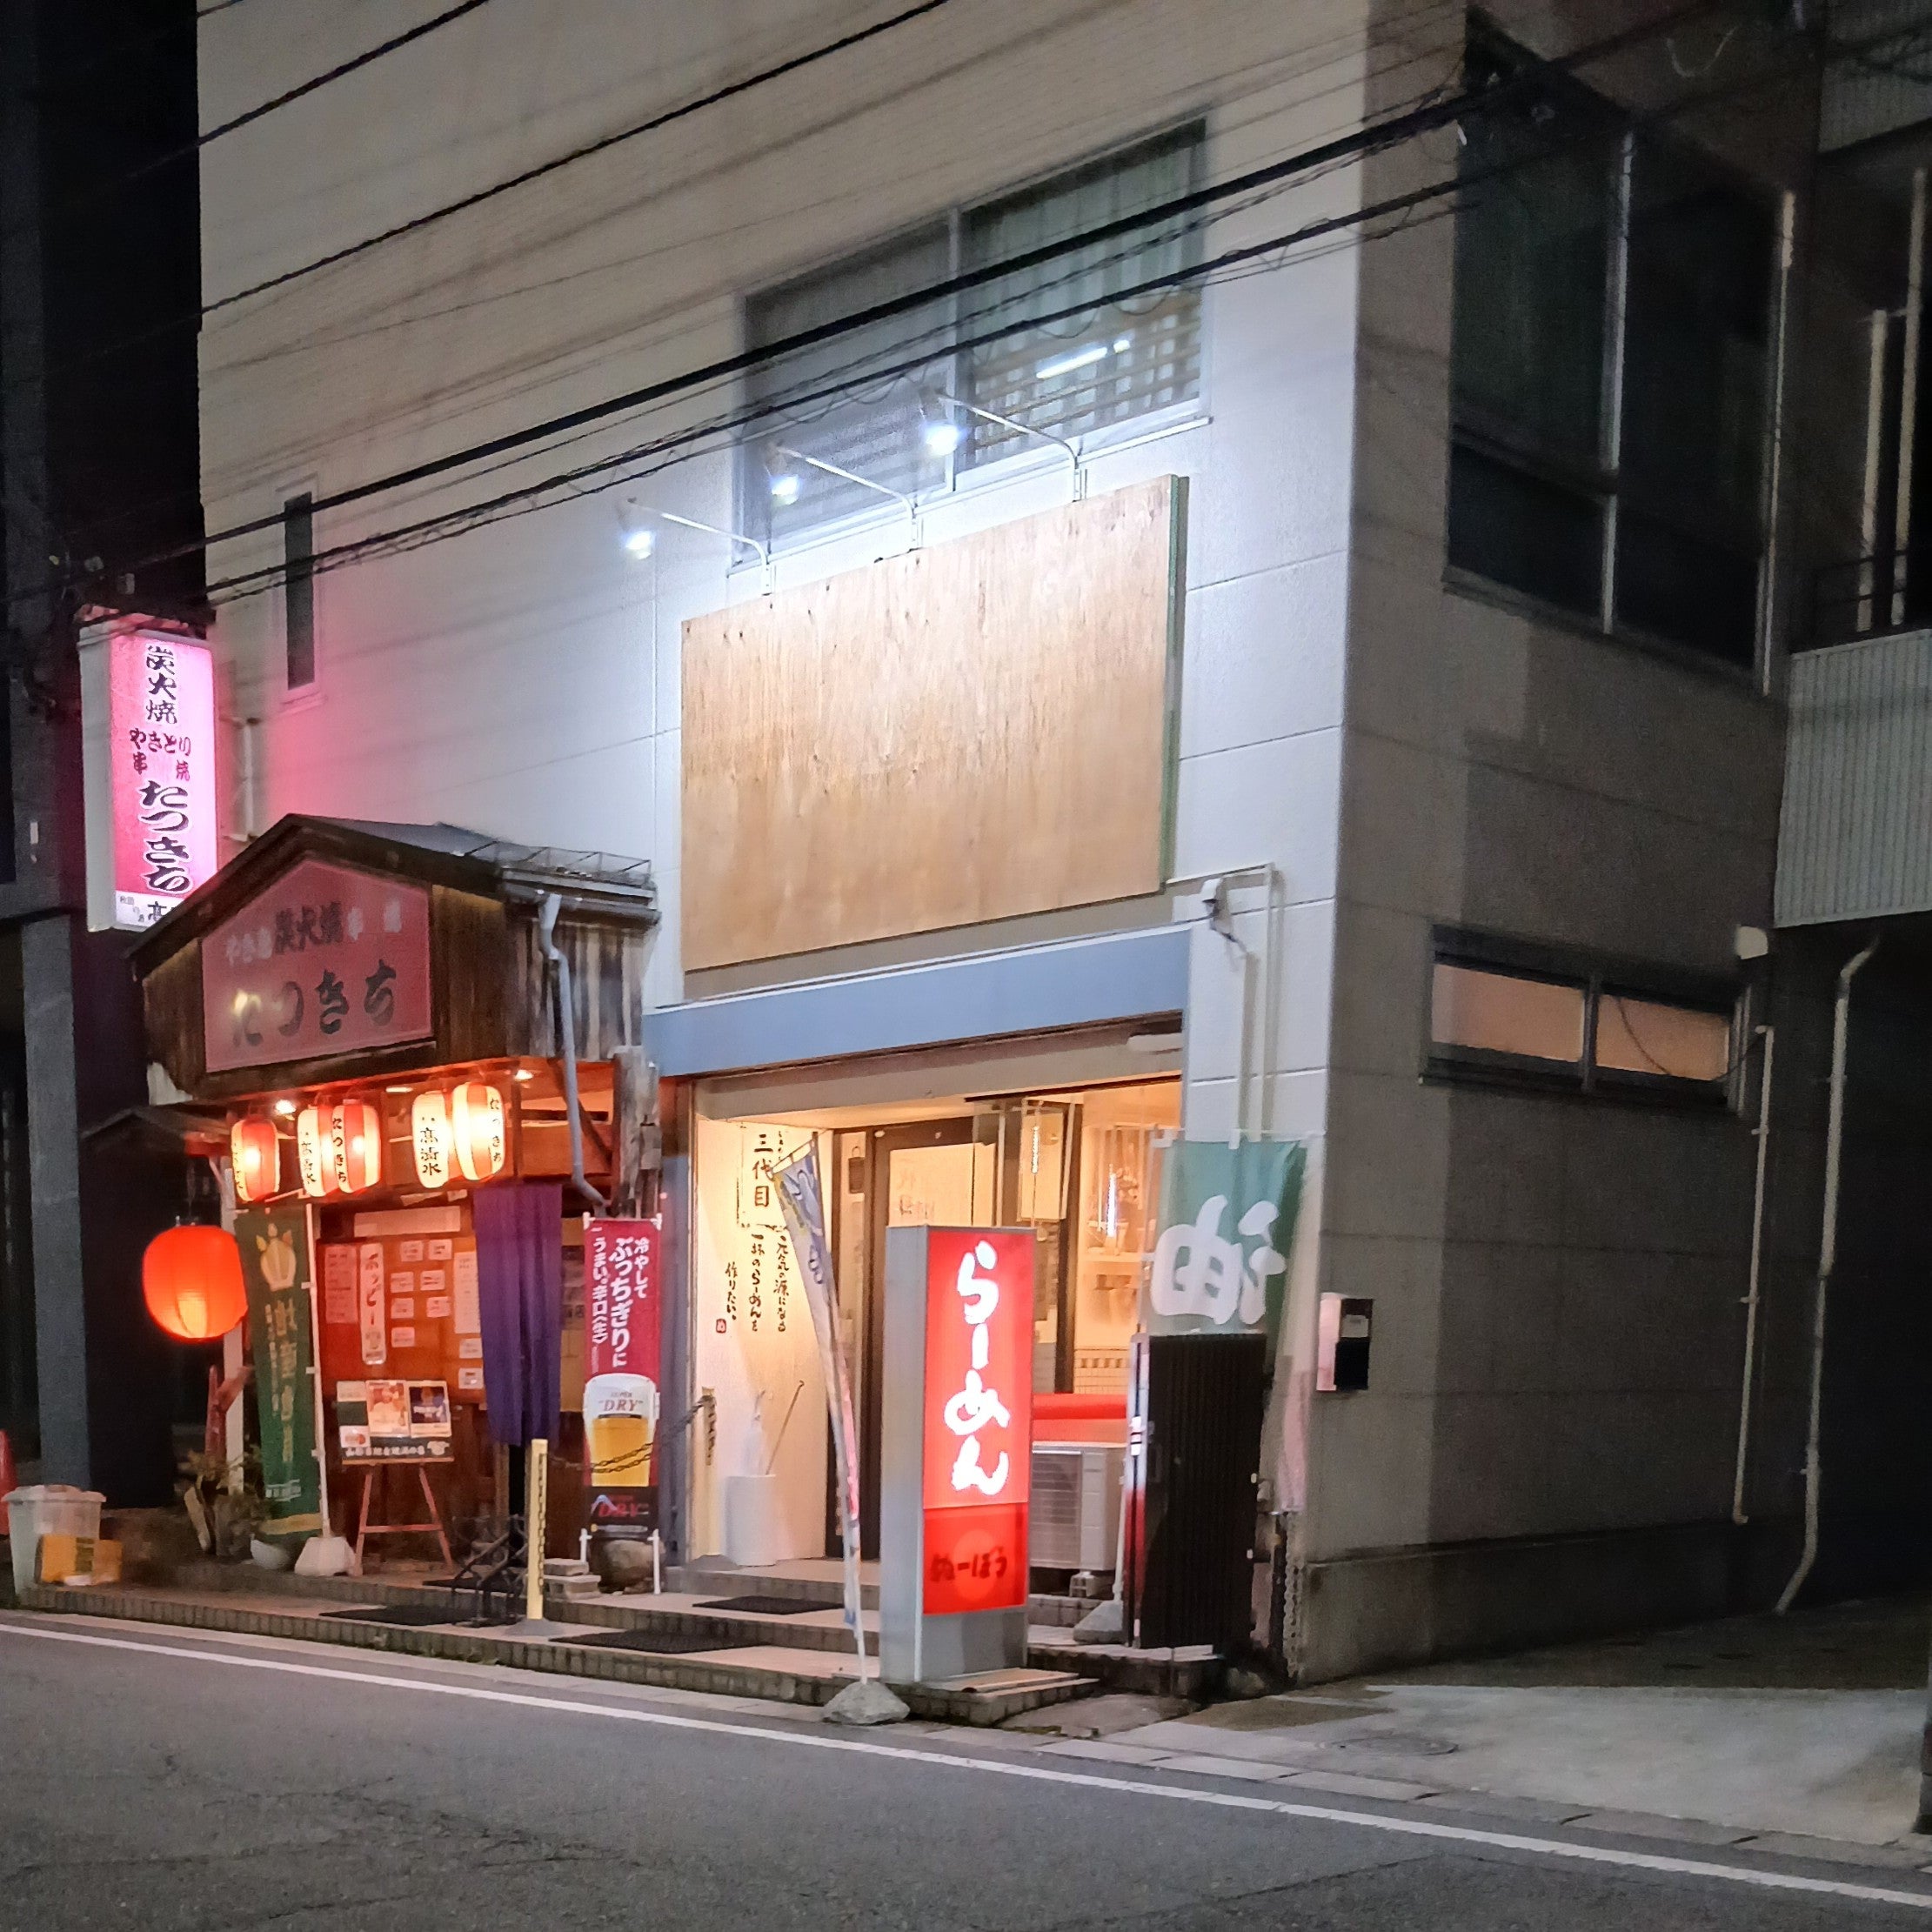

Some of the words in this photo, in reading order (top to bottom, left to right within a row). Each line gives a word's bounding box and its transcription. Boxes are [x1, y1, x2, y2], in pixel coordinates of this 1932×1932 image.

[146, 645, 177, 724] 炭火焼
[130, 728, 191, 756] やきとり
[139, 780, 191, 892] たつきち
[634, 1237, 650, 1298] 冷やして
[944, 1240, 1011, 1495] らーめん
